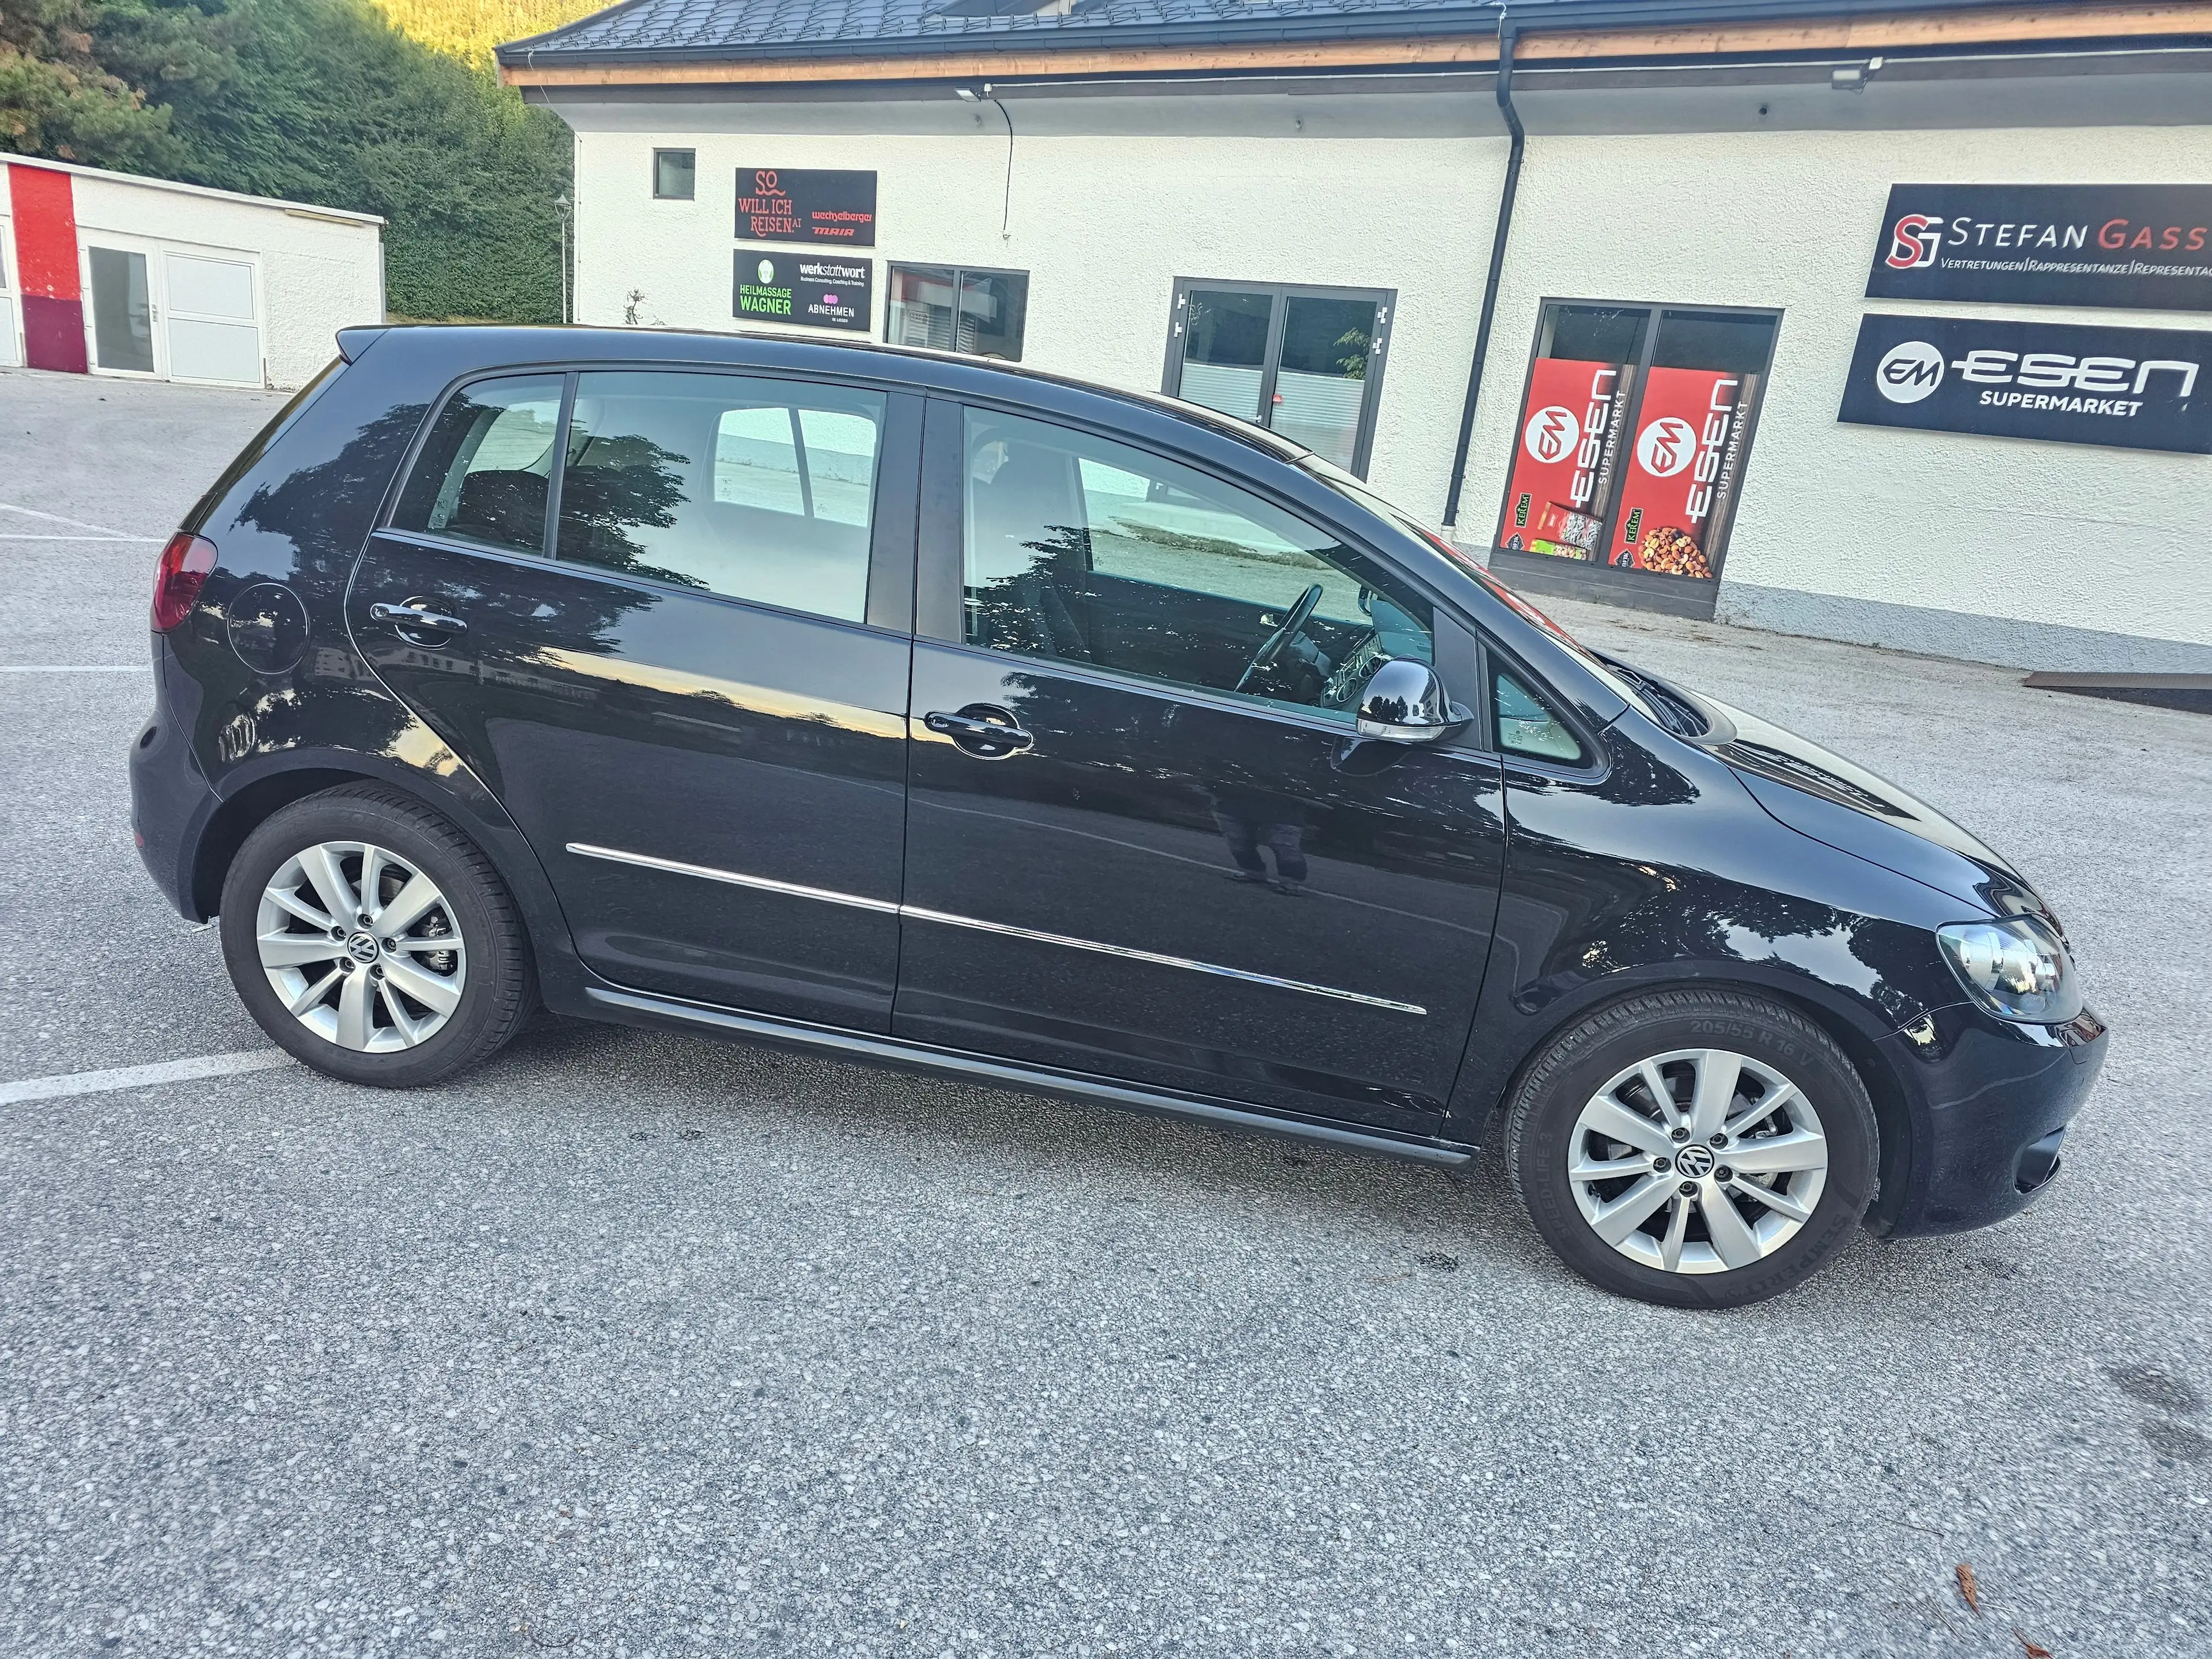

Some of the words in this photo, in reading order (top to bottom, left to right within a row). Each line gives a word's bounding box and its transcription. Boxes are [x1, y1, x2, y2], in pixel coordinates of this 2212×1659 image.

[755, 171, 786, 196] SO
[738, 198, 769, 214] WILL
[771, 199, 793, 215] ICH
[812, 211, 872, 223] wechselberger
[1948, 216, 2089, 249] STEFAN
[2097, 218, 2212, 252] GASS
[800, 262, 865, 279] werkstattwort
[740, 284, 792, 298] HEILMASSAGE
[740, 296, 791, 315] WAGNER
[808, 304, 854, 317] ABNEHMEN
[1979, 390, 2143, 417] SUPERMARKET
[1597, 390, 1627, 484] SUPERMARKT
[1717, 400, 1749, 500] SUPERMARKT
[1517, 495, 1528, 525] KEREM
[1627, 510, 1640, 542] KEREM
[1690, 1020, 1754, 1041] 205/55
[1758, 1030, 1774, 1045] R
[1775, 1036, 1794, 1056] 16
